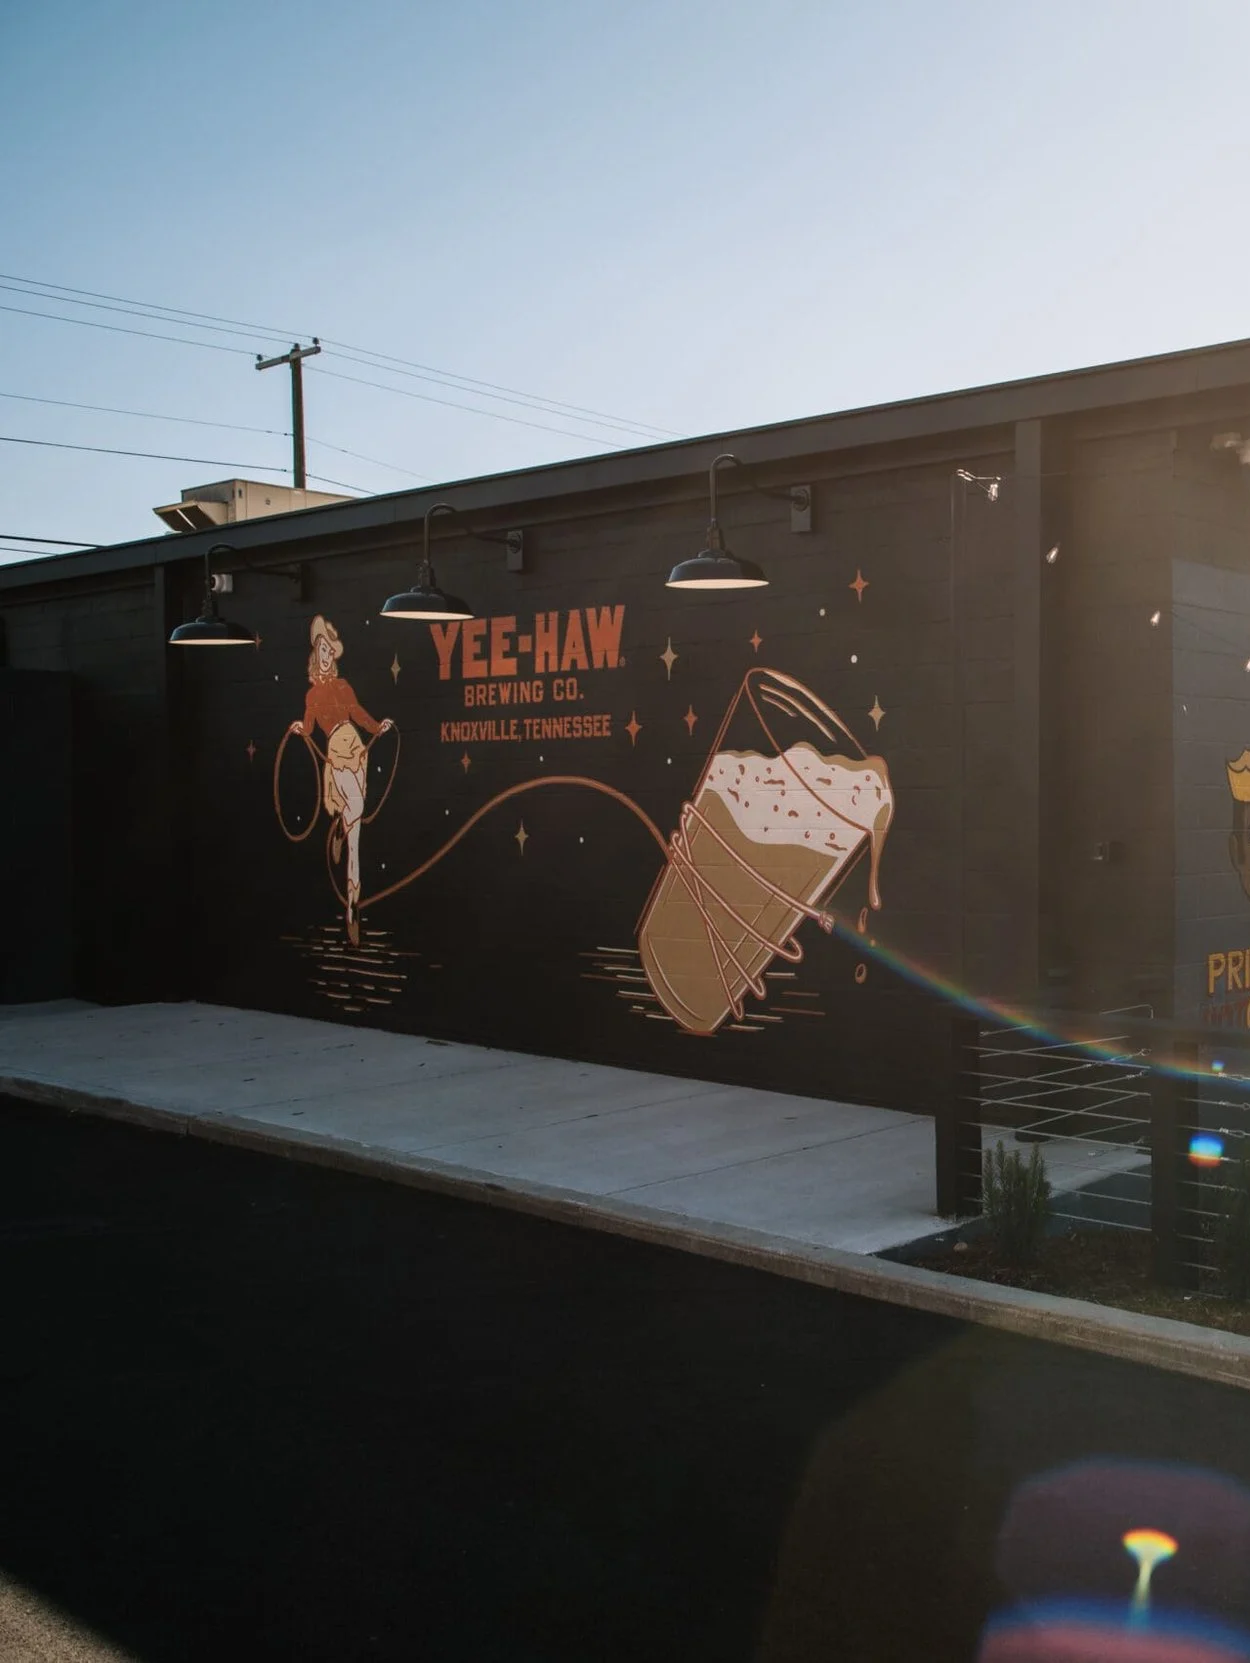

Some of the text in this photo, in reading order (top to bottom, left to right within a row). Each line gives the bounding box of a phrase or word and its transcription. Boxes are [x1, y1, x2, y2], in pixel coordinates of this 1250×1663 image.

[429, 604, 625, 681] YEE-HAW
[464, 677, 585, 707] BREWING CO.
[441, 714, 612, 743] KNOXVILLE, TENNESSEE
